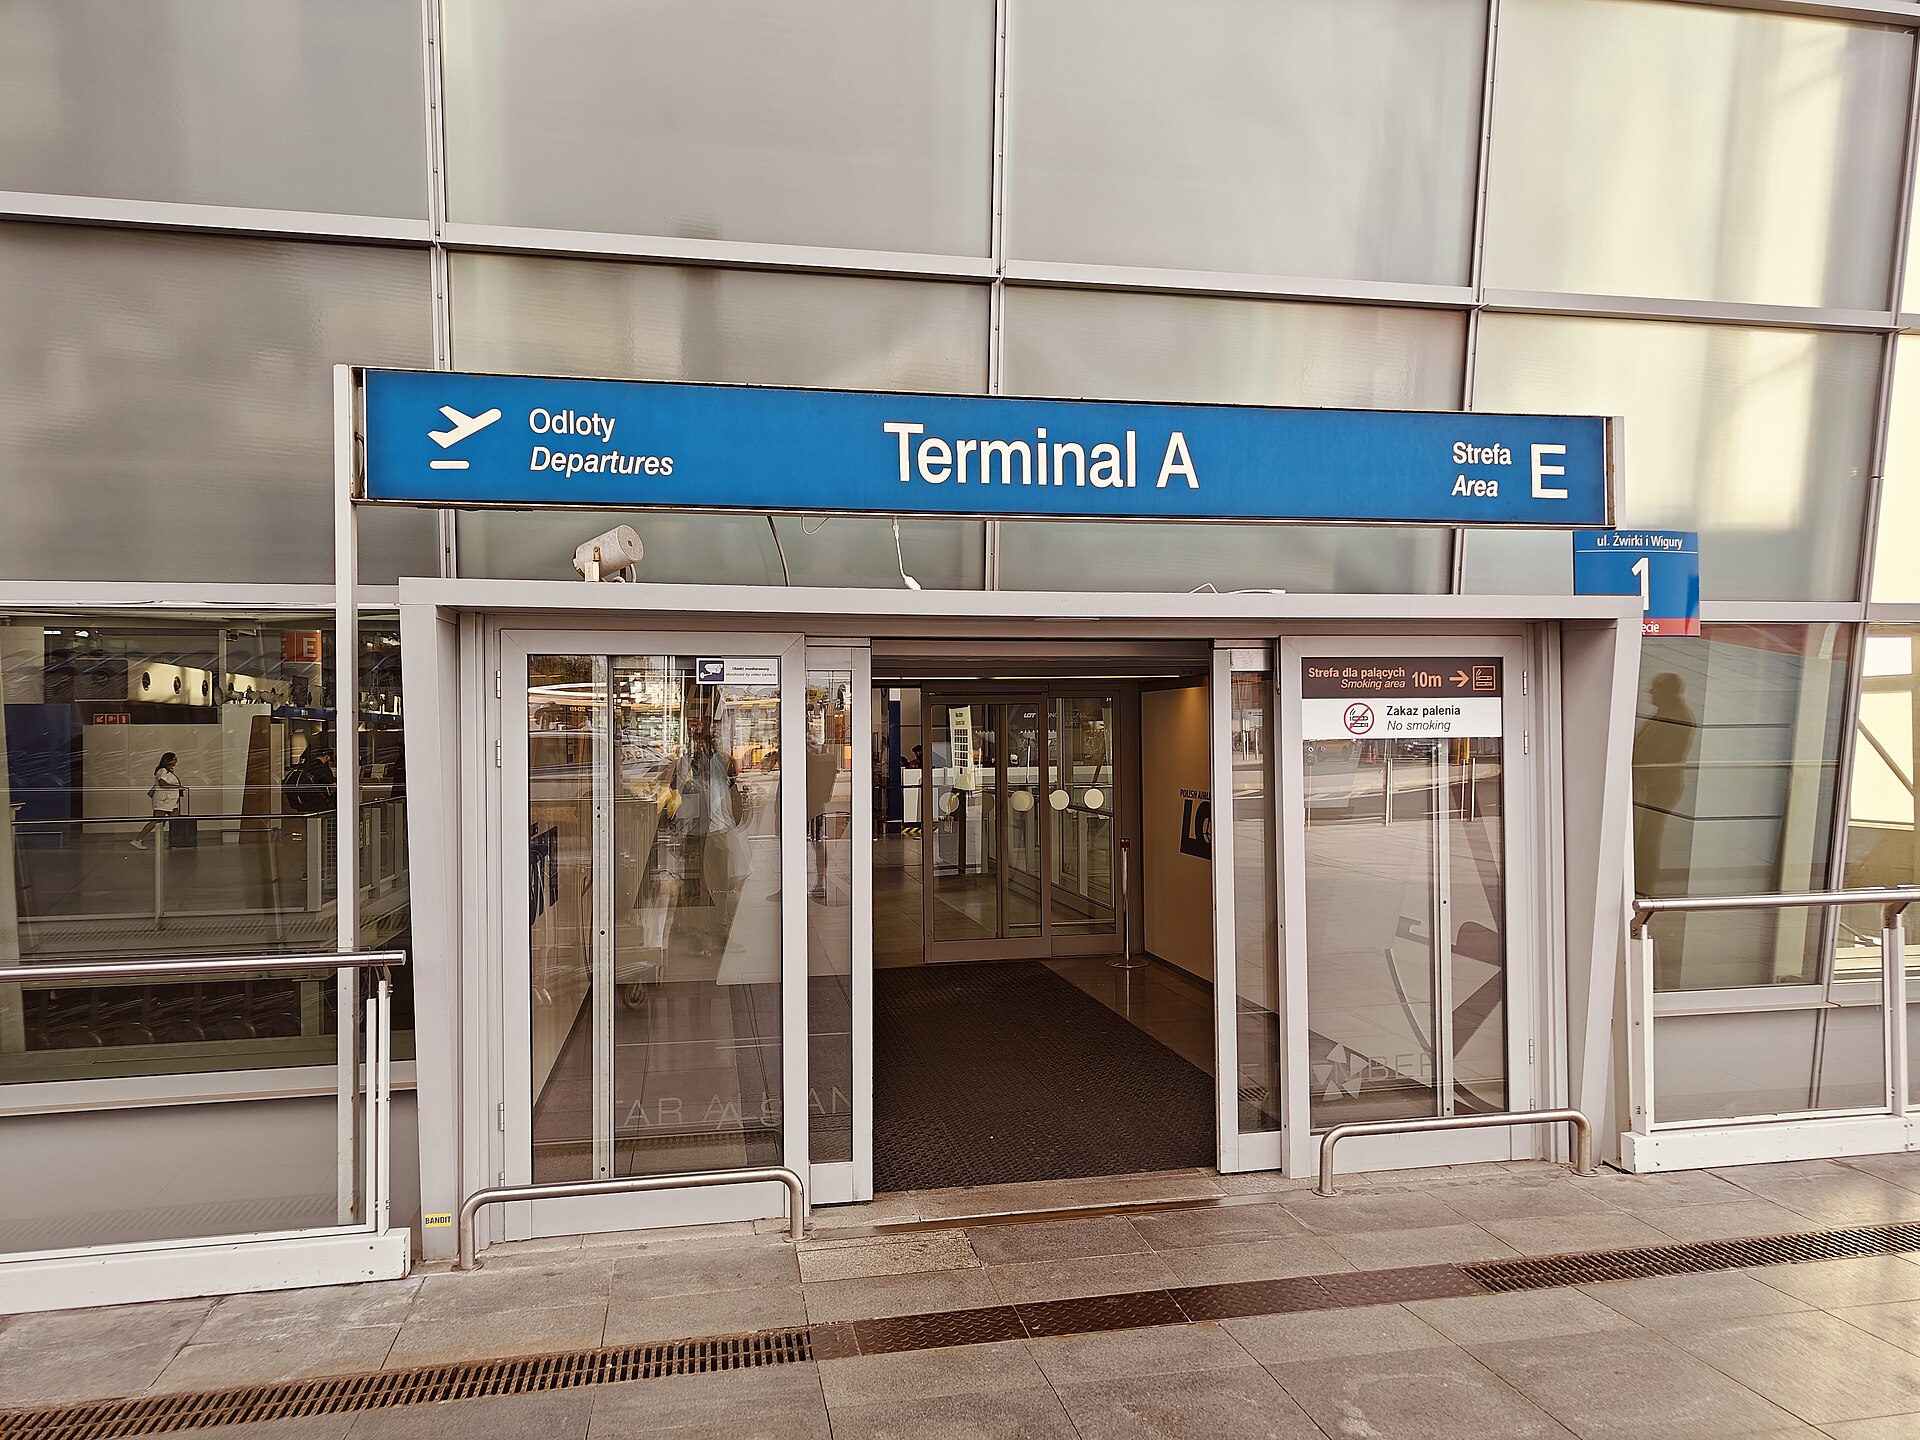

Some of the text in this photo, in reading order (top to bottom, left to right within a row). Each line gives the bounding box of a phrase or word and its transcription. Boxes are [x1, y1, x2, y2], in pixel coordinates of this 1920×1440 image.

[529, 408, 615, 443] Odloty
[529, 447, 674, 478] Departures
[884, 423, 1200, 489] Terminal A
[1452, 442, 1512, 466] Strefa
[1530, 443, 1569, 499] E
[1451, 475, 1499, 498] Area
[1597, 532, 1683, 550] ul. Żwirki i Wigury
[1631, 557, 1650, 611] 1
[1641, 621, 1660, 635] ęcie
[1308, 667, 1405, 680] Strefa dla palących
[1412, 671, 1442, 688] 10m
[1341, 679, 1406, 691] Smoking area
[1386, 704, 1461, 718] Zakaz palenia
[1386, 719, 1451, 733] No smoking
[425, 1216, 452, 1224] BANDIT
